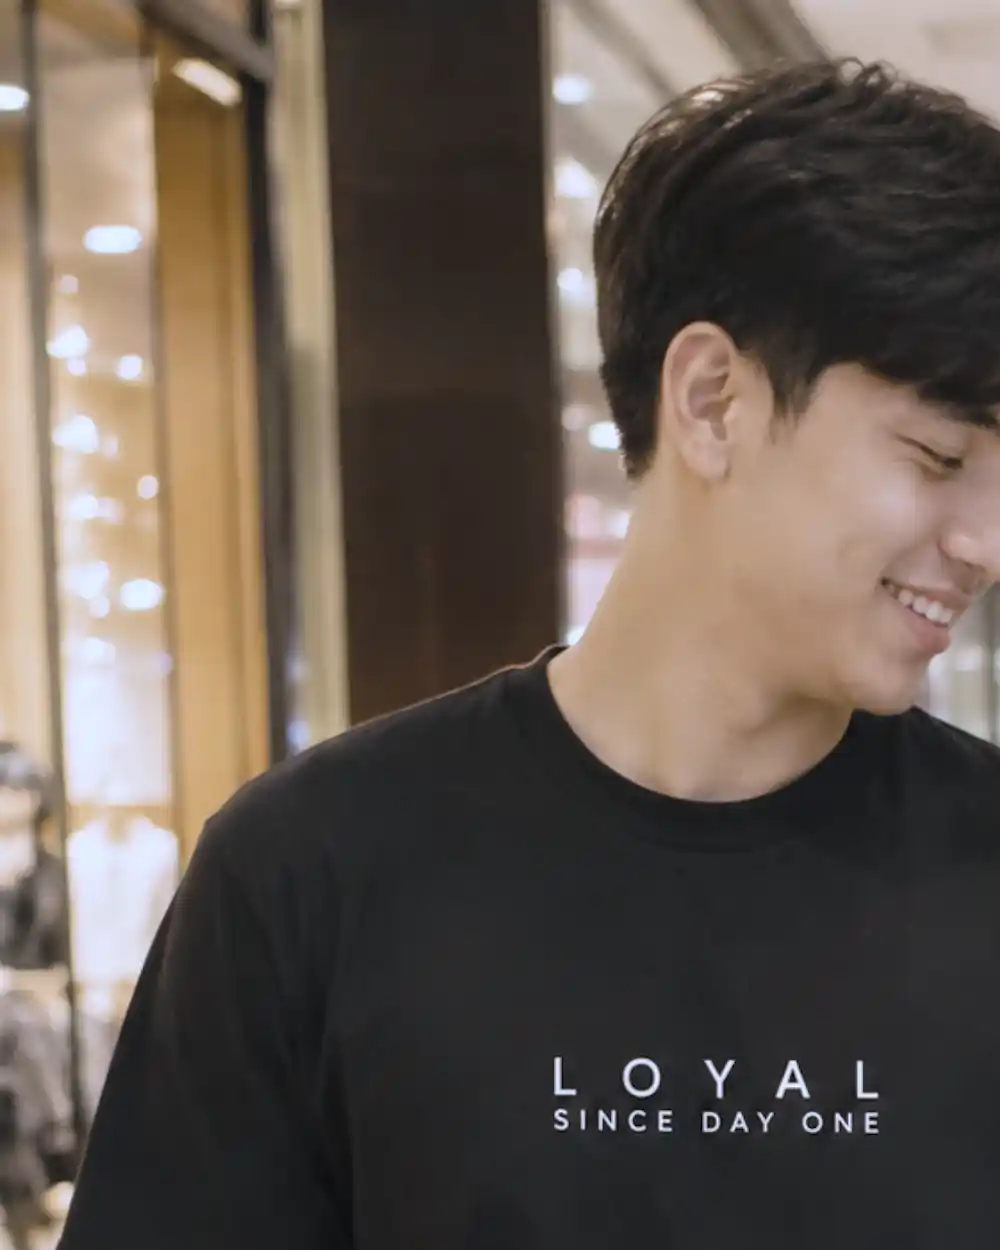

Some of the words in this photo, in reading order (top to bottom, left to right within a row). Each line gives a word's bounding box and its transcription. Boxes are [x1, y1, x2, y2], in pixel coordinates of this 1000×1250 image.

[553, 1056, 880, 1100] LOYAL
[553, 1108, 674, 1133] SINCE
[701, 1111, 776, 1134] DAY
[801, 1111, 880, 1135] ONE
